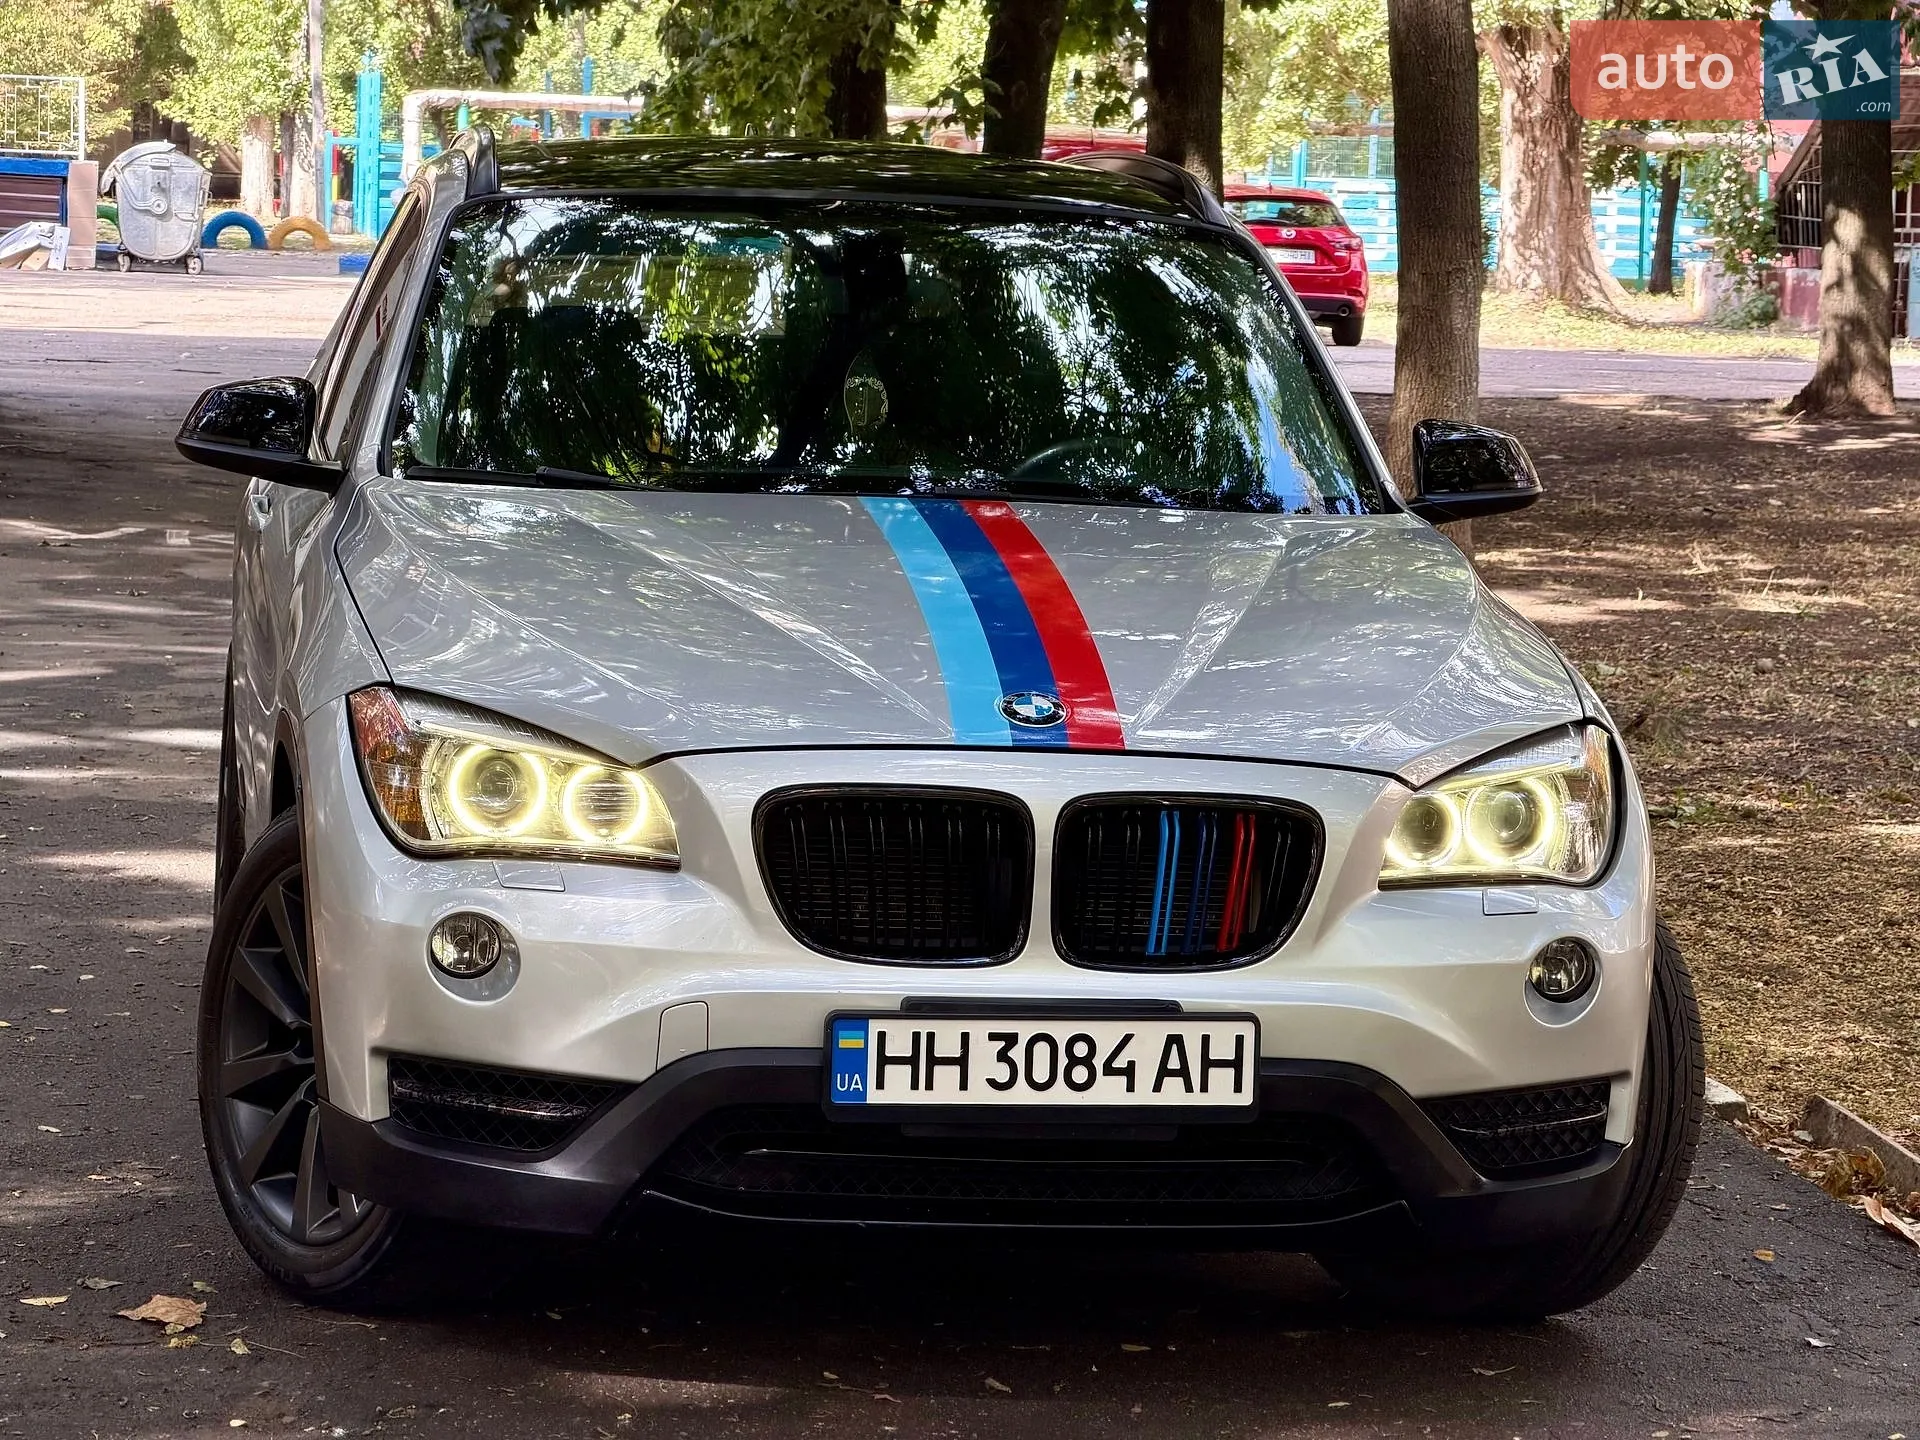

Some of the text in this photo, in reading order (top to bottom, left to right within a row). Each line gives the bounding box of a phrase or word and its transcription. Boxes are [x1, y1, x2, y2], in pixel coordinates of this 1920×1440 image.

[836, 1073, 864, 1092] UA
[875, 1030, 1246, 1094] HH 3084 AH
